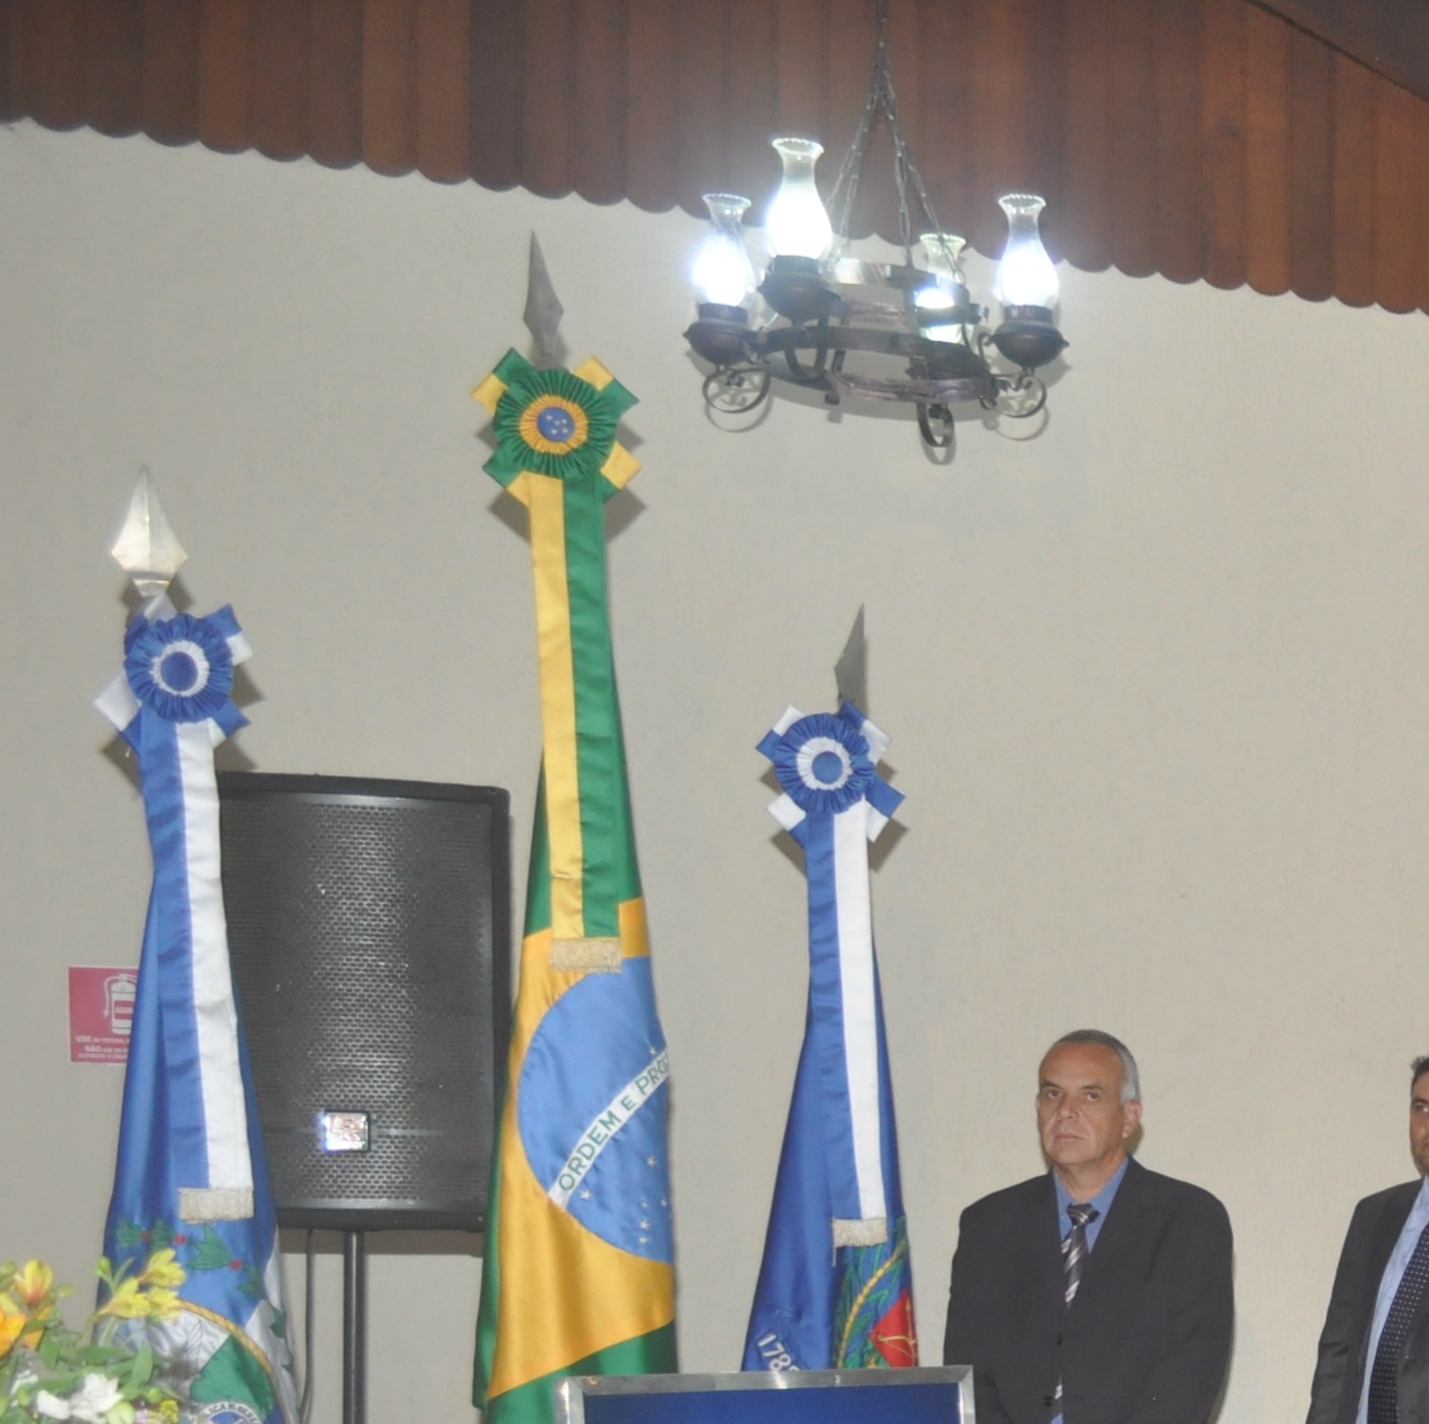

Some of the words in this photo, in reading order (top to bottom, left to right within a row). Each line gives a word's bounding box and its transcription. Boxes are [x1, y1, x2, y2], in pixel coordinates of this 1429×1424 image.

[558, 1109, 623, 1192] ORDEM
[620, 1094, 638, 1111] E
[634, 1056, 669, 1096] PRO
[757, 1333, 801, 1371] 178
